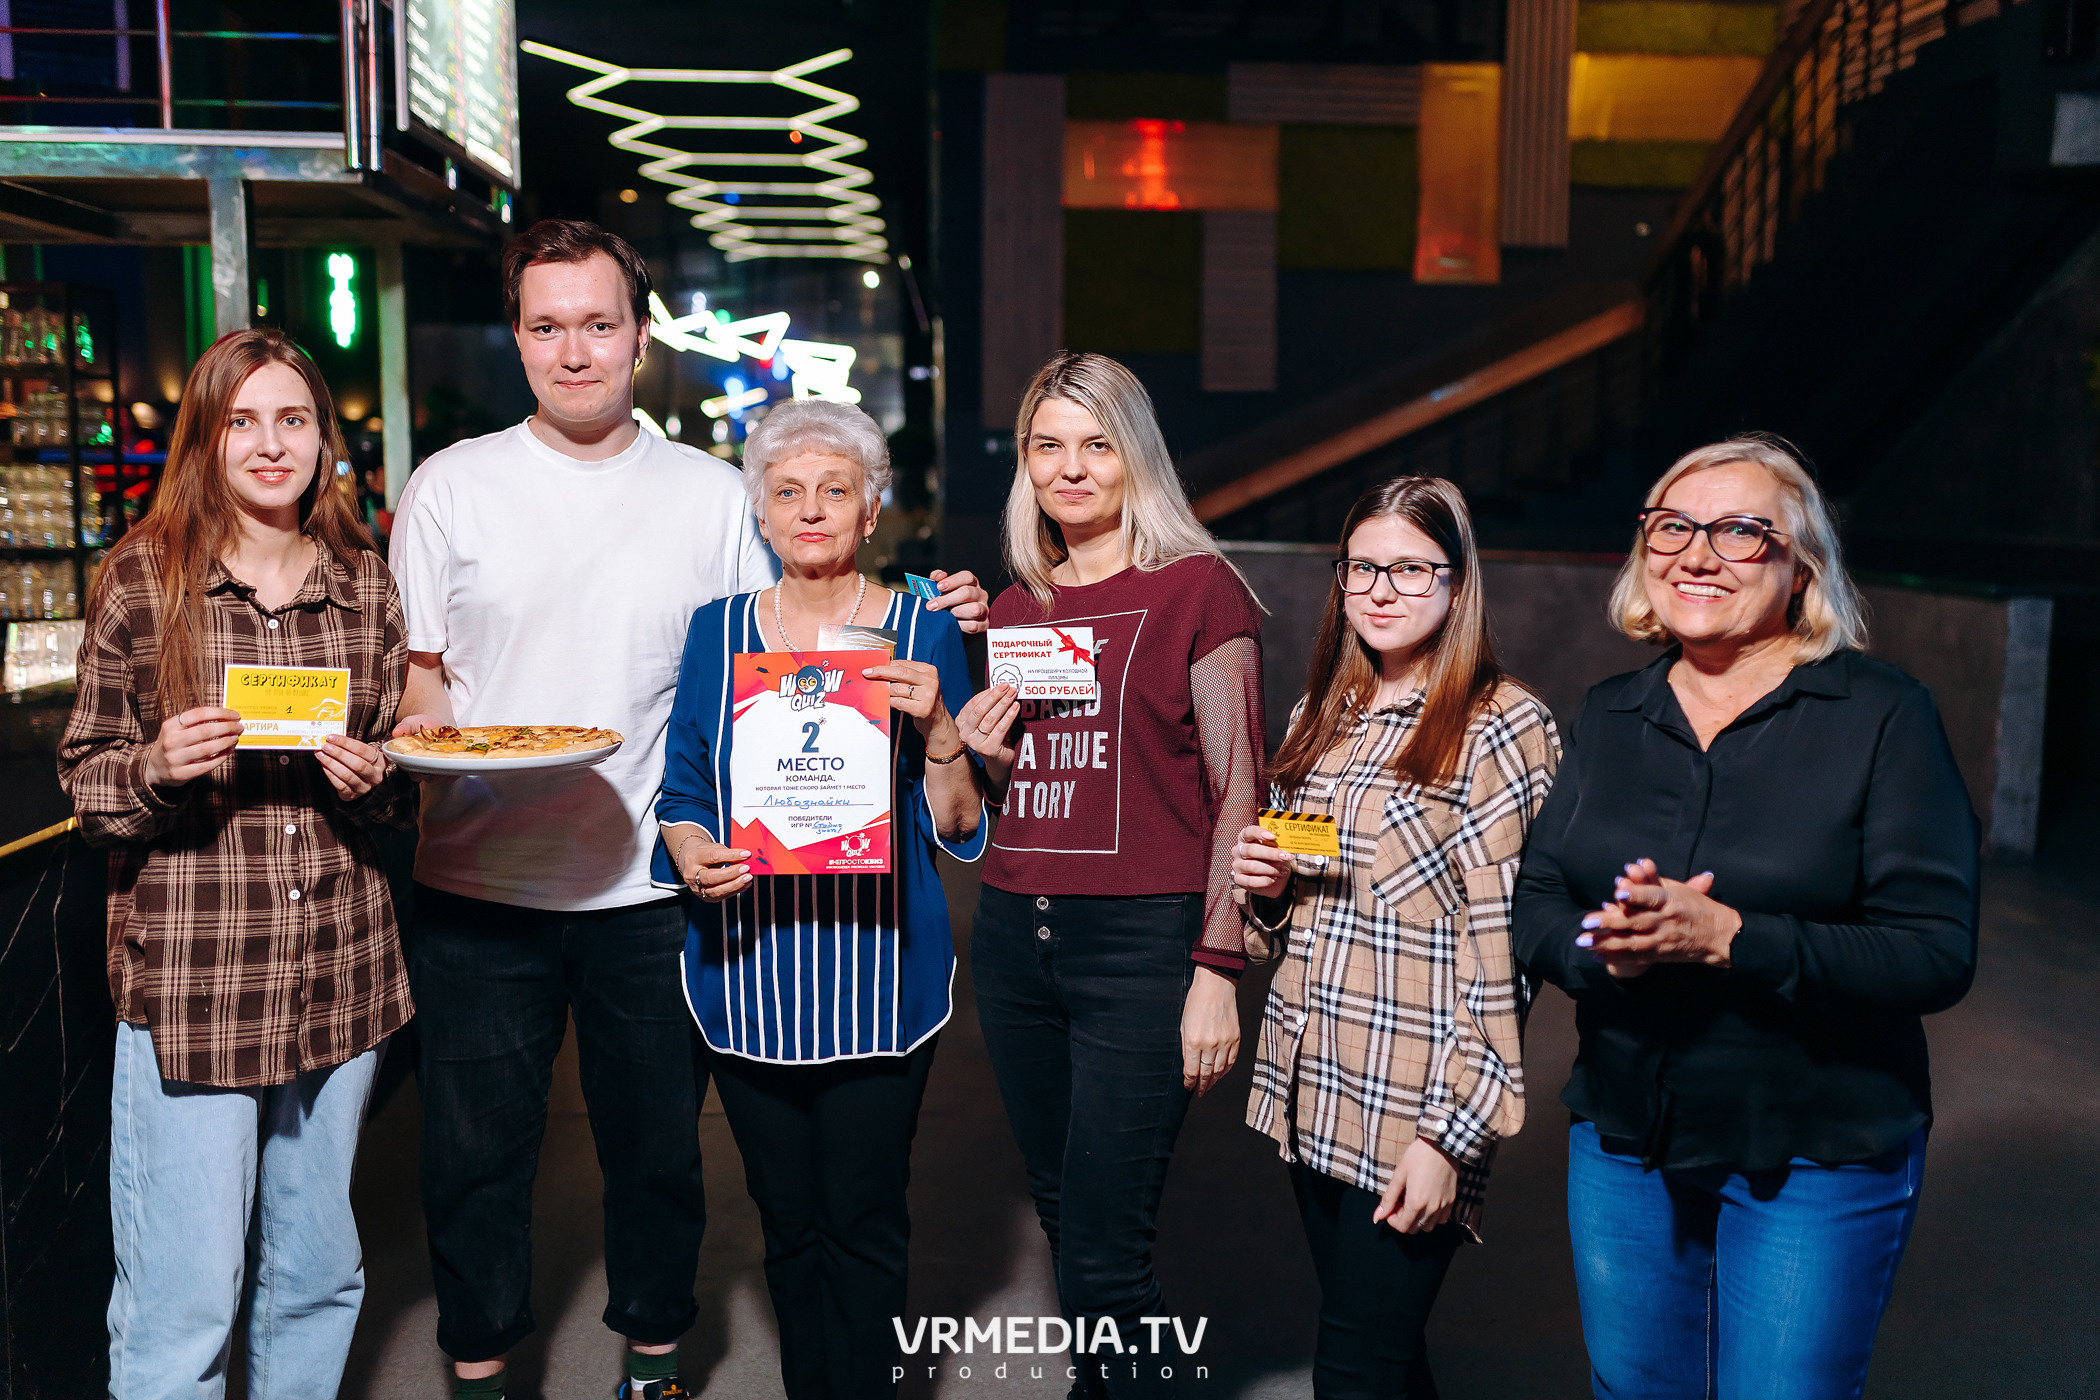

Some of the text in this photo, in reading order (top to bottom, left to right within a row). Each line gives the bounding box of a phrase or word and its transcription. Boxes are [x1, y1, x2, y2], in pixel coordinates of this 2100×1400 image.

[992, 639, 1053, 648] ПОДАРОЧНЫЙ
[993, 650, 1052, 659] СЕРТИФИКАТ
[240, 673, 338, 688] СЕРТИФИКАТ
[779, 665, 845, 698] WOW
[1024, 683, 1094, 695] 500 РУБЛЕЙ
[790, 691, 826, 712] QUIZ
[242, 722, 279, 731] АРТИРА
[802, 721, 820, 753] 2
[1016, 731, 1109, 770] A TRUE
[776, 757, 845, 772] МЕСТО
[763, 794, 851, 809] Любознайки
[1284, 822, 1329, 833] СЕРТИФИКАТ
